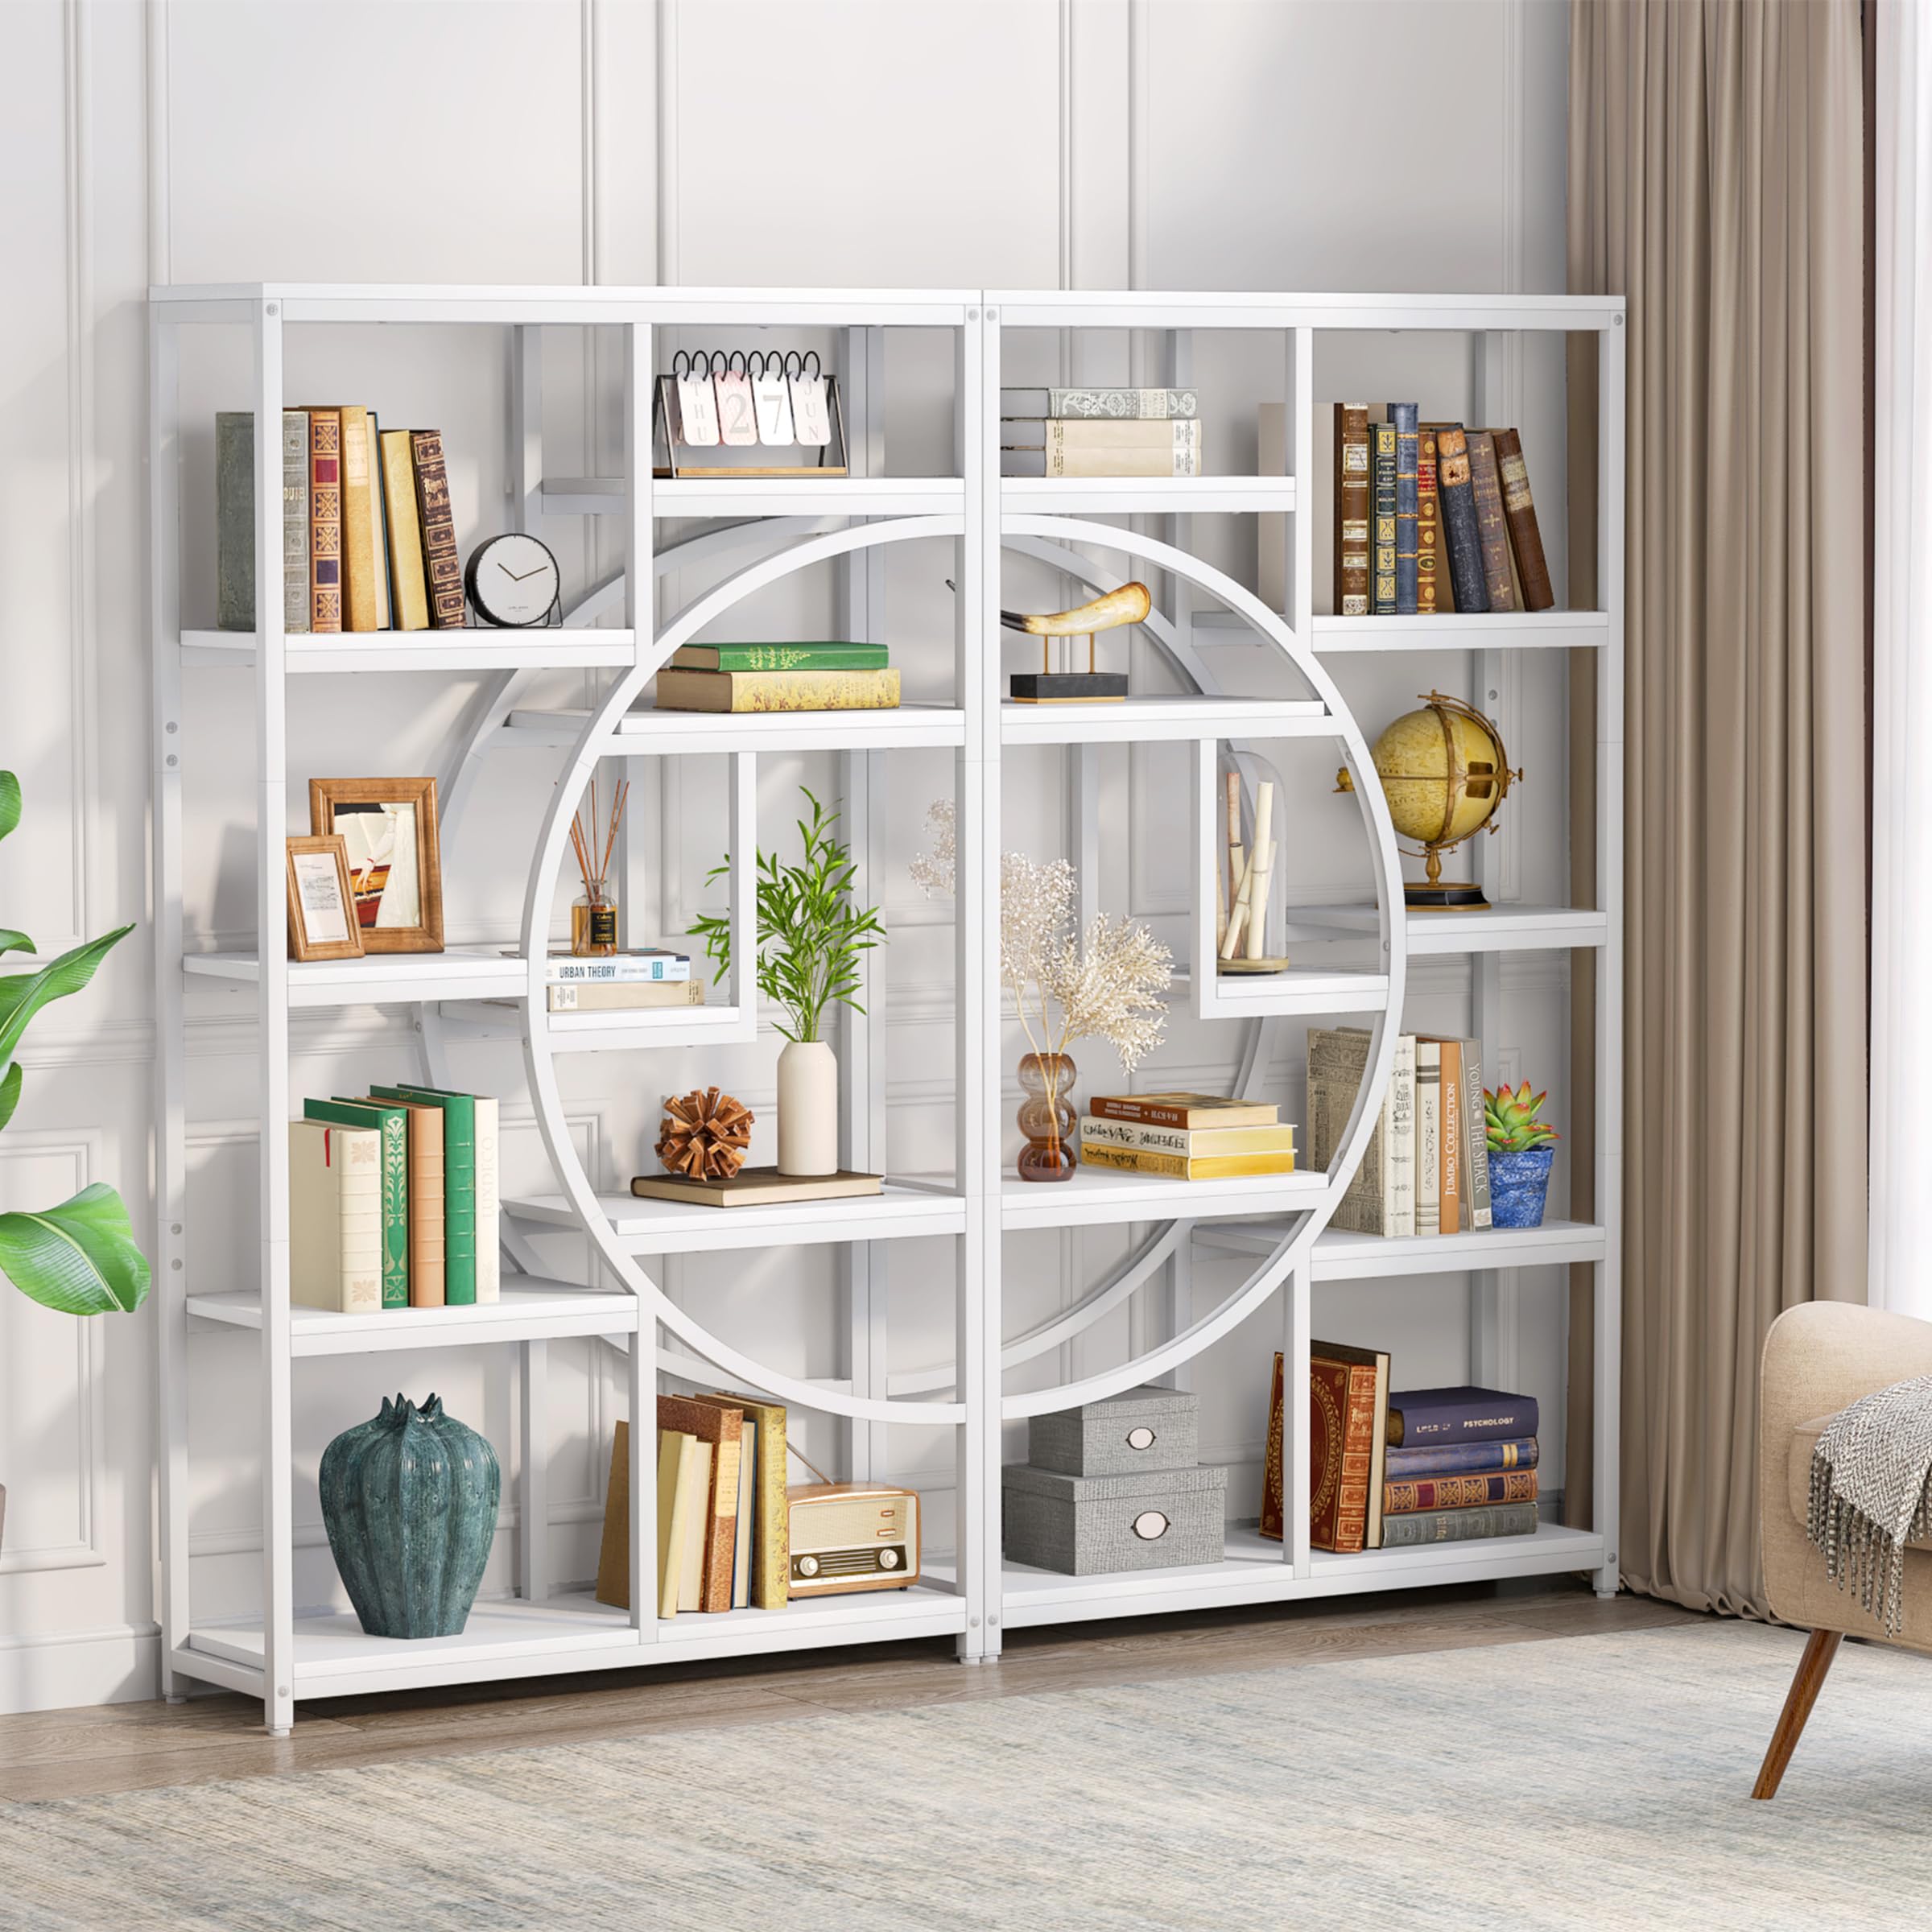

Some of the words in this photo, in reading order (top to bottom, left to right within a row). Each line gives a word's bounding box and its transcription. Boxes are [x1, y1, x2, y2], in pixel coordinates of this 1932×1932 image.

[690, 381, 708, 442] THU
[804, 381, 819, 440] JUN
[559, 966, 585, 978] URBAN
[588, 965, 616, 977] THEORY
[1468, 1063, 1481, 1108] YOUNG
[1471, 1121, 1484, 1149] THE
[1472, 1150, 1488, 1194] SHACK
[1463, 1417, 1514, 1428] PSYCHOLOGY
